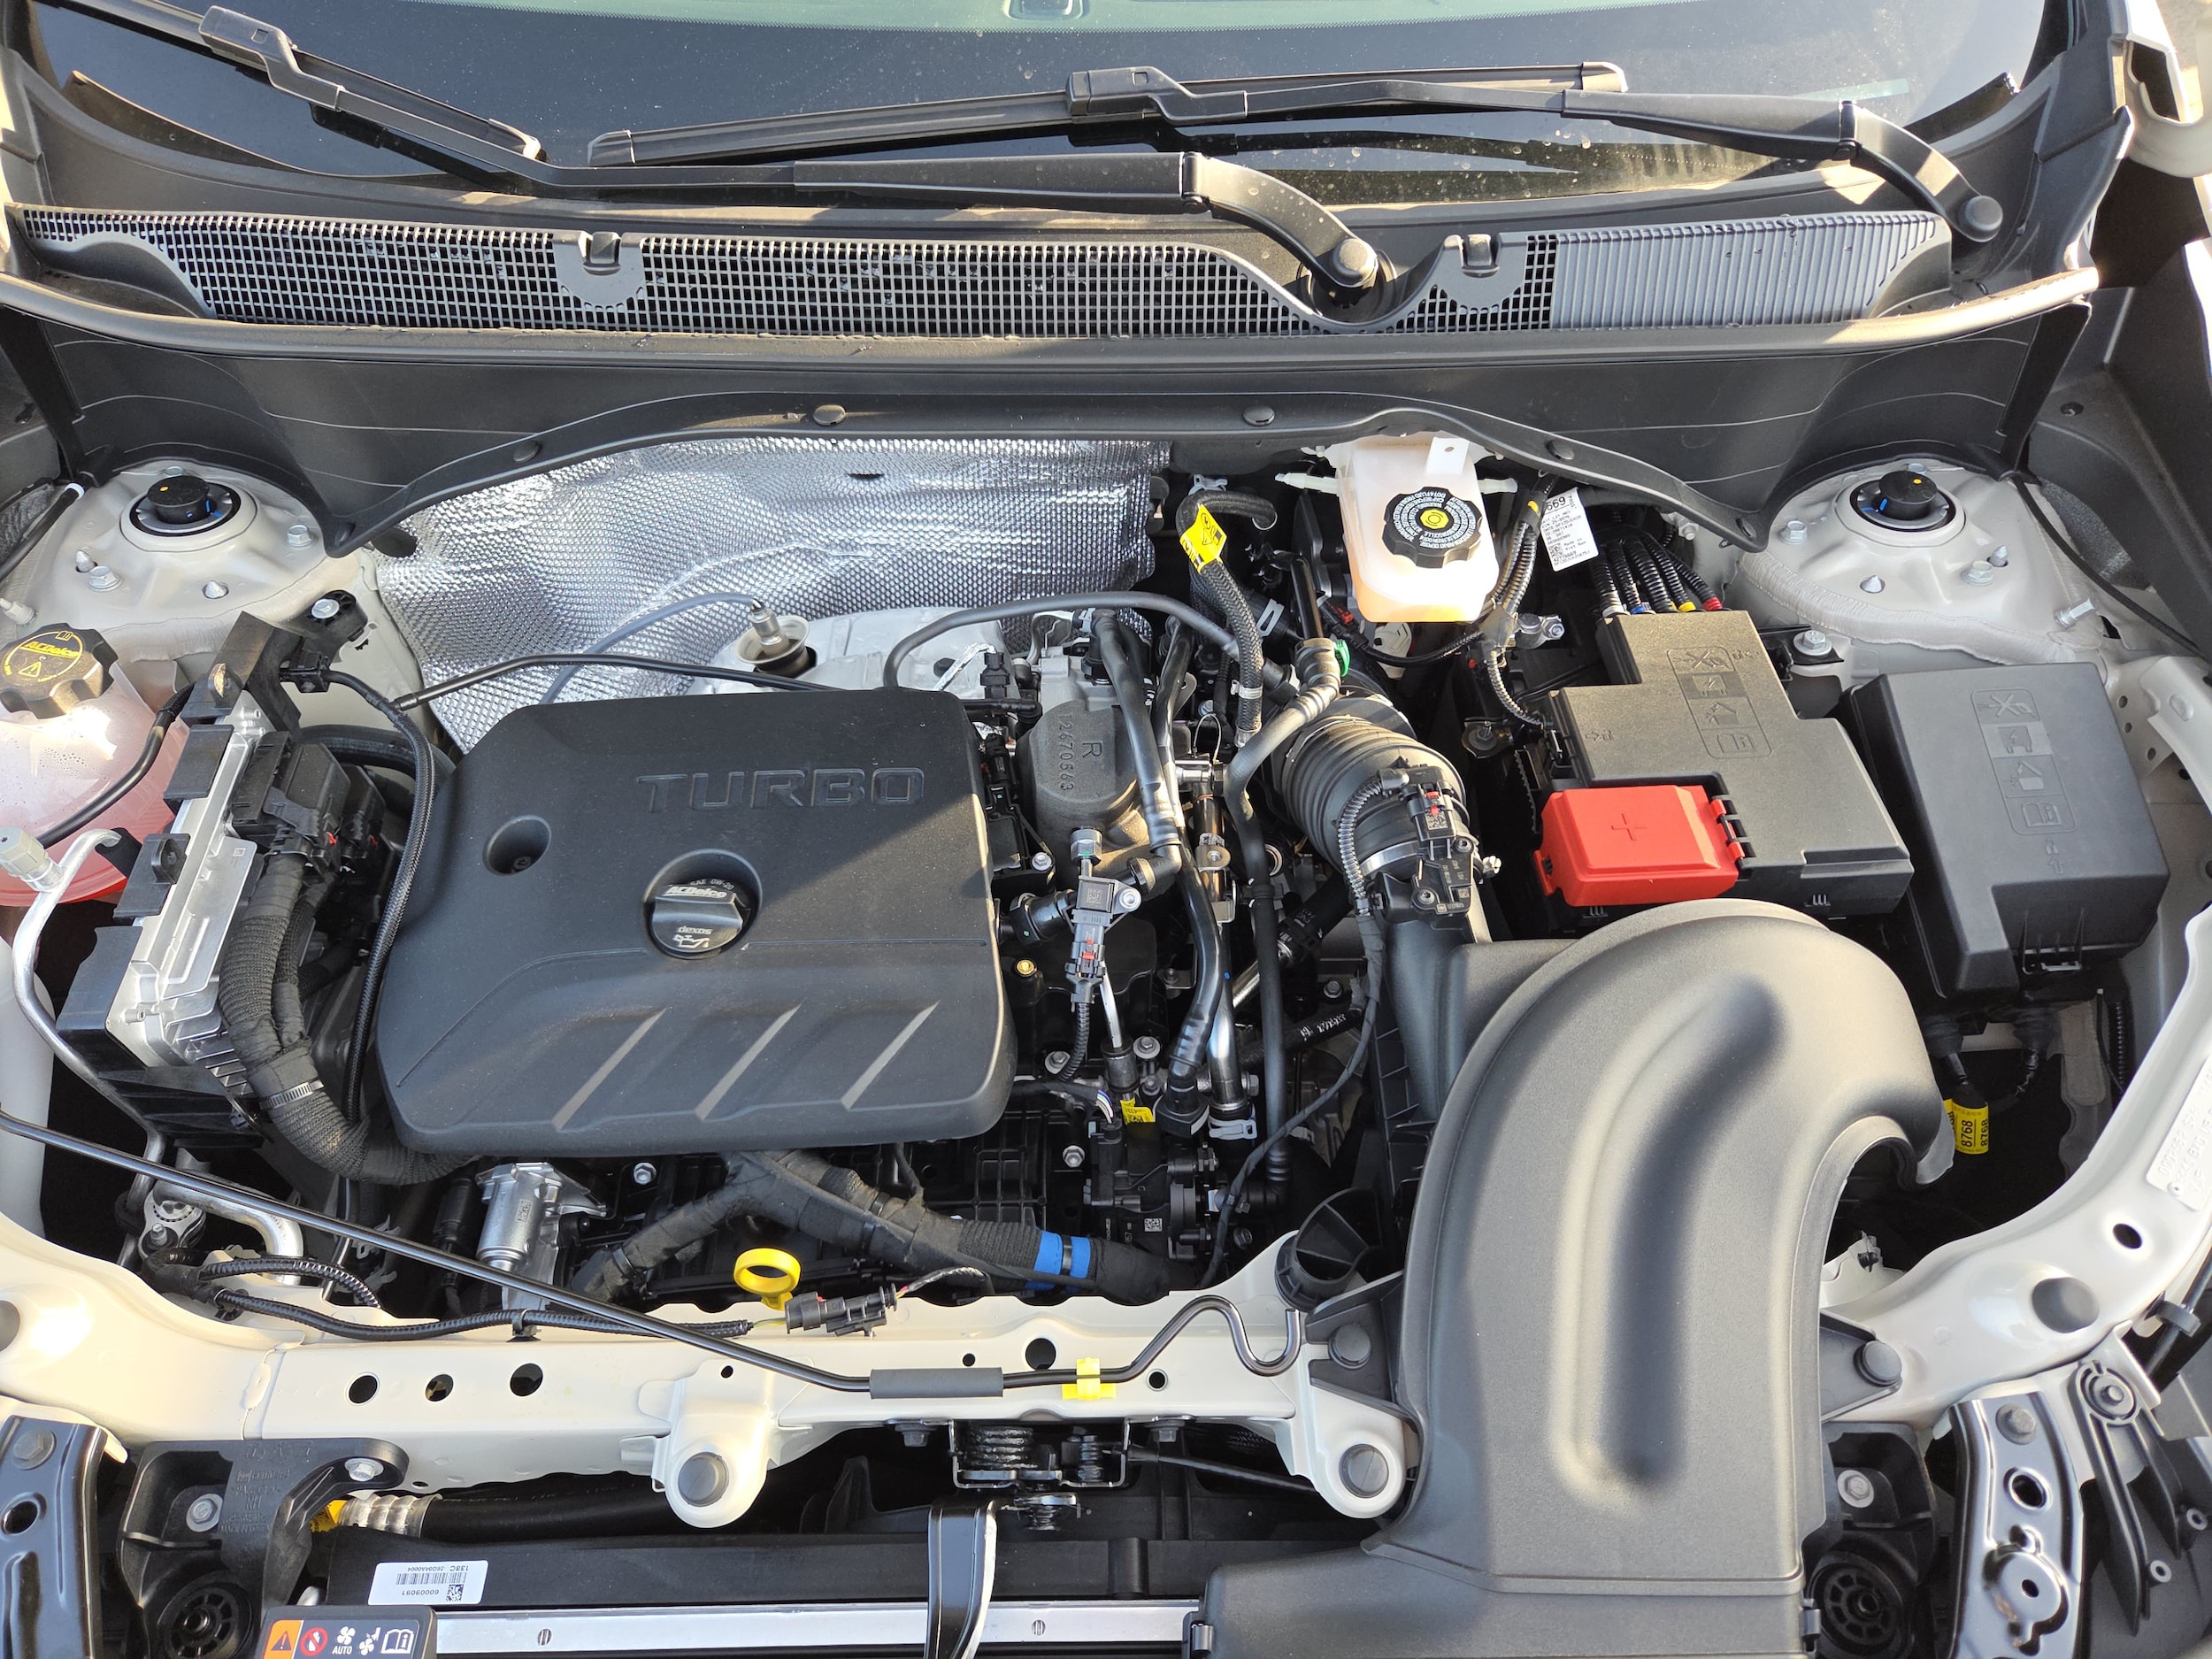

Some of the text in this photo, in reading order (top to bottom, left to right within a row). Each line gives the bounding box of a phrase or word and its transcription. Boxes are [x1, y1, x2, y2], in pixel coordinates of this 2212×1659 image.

[23, 641, 81, 659] ACDelco
[1082, 740, 1103, 758] R
[636, 768, 925, 814] TURBO
[710, 879, 734, 890] 0W-20
[663, 886, 727, 899] ACDelco
[678, 926, 713, 934] dexos
[1961, 1119, 1973, 1147] 8768
[332, 1646, 352, 1655] AUTO
